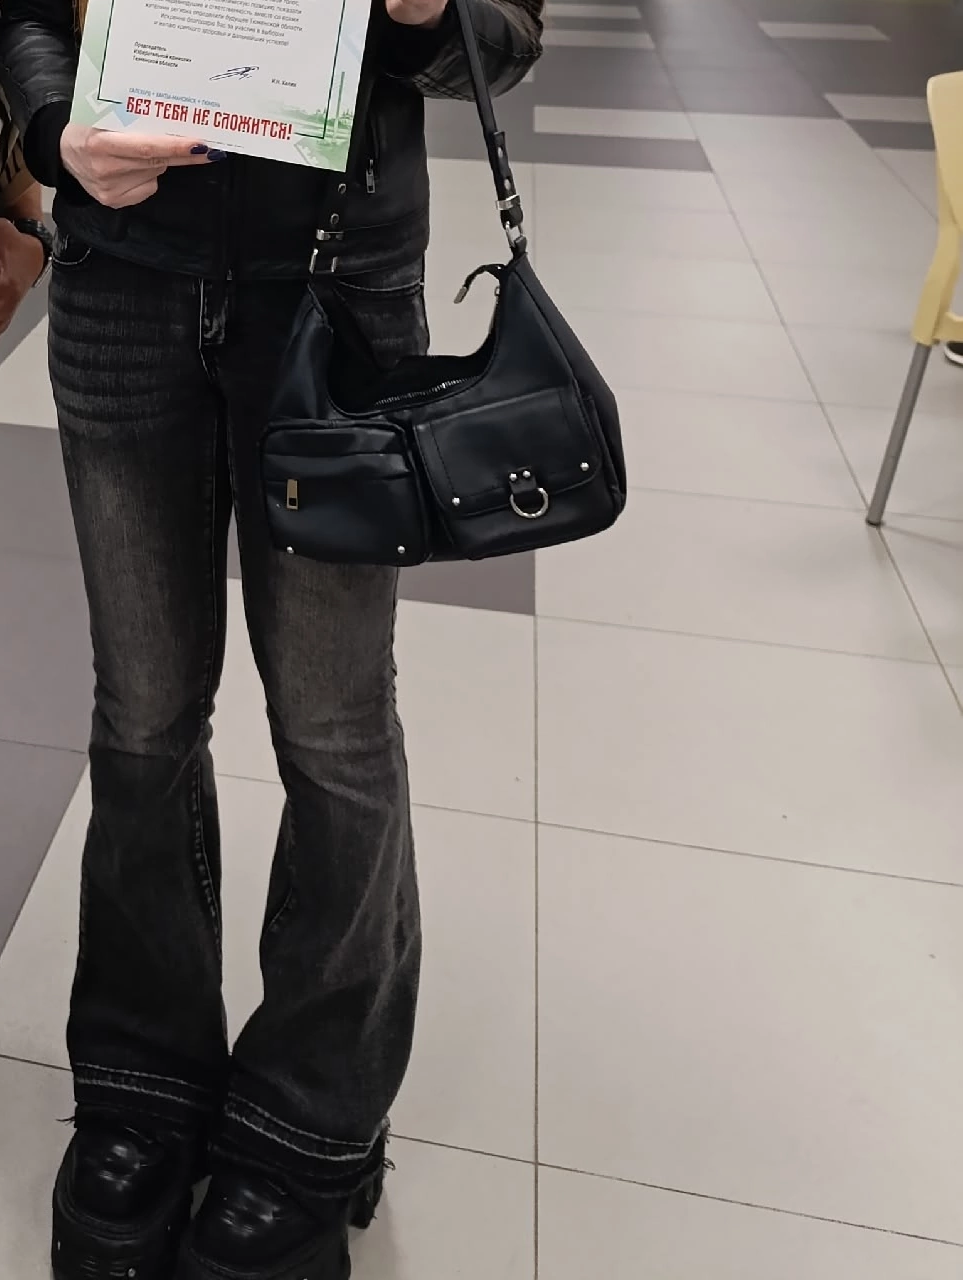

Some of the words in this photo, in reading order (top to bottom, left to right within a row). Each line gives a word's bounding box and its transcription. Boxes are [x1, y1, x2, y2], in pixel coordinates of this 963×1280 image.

[126, 96, 152, 116] БЕЗ
[154, 102, 188, 122] ТЕБЯ
[192, 108, 211, 126] НЕ
[213, 111, 293, 140] СЛОЖИТСЯ!
